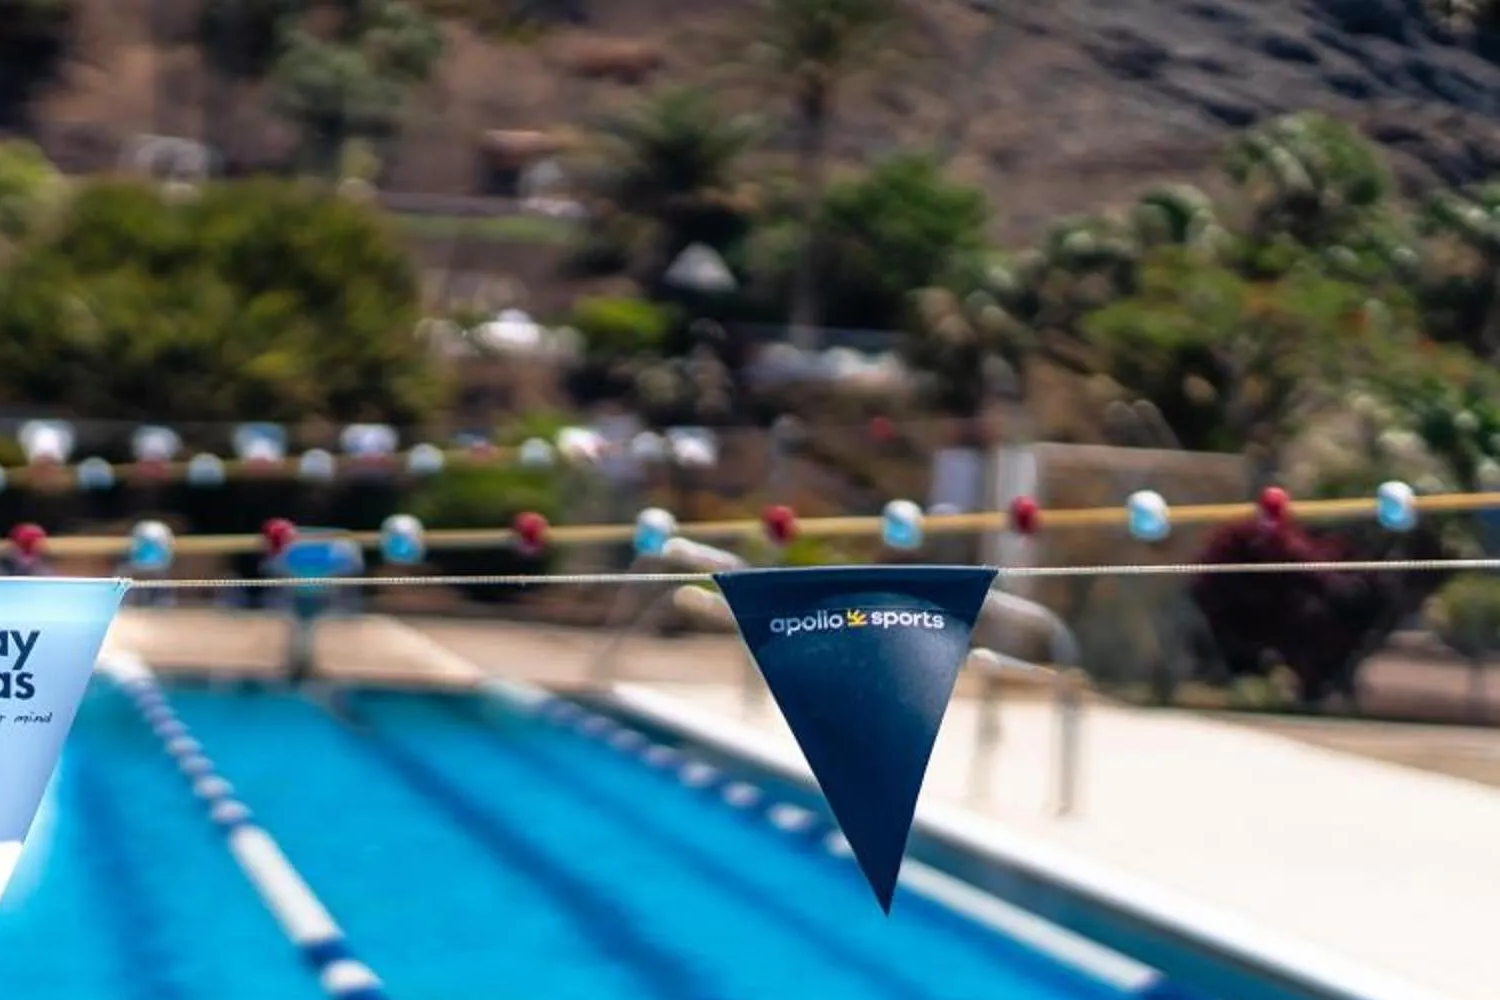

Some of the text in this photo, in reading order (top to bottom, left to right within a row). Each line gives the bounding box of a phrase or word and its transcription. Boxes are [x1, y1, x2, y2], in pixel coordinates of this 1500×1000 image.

[769, 609, 945, 637] apollo sports
[13, 711, 53, 724] mind
